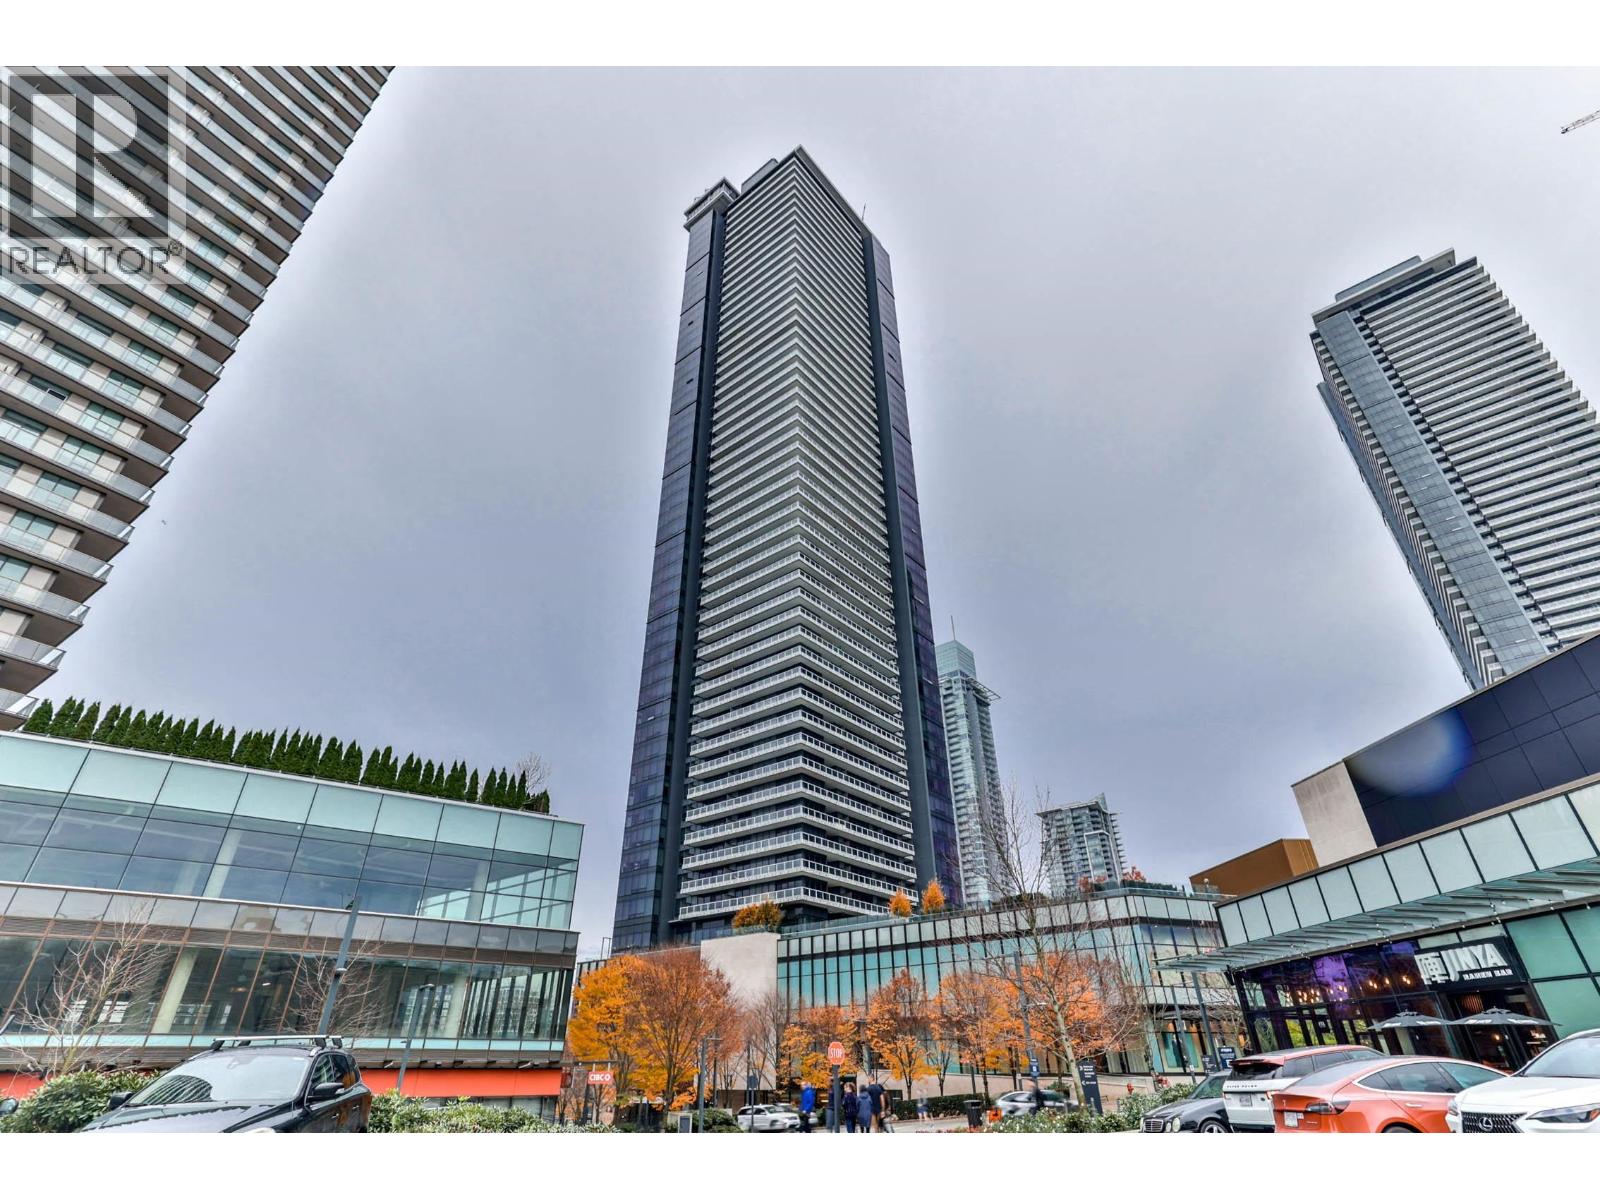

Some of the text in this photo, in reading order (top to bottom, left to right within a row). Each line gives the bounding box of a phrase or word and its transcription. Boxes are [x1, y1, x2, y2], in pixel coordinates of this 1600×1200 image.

[1440, 943, 1508, 983] JINYA
[1462, 968, 1514, 981] RAMEN BAR
[830, 1047, 843, 1058] STOP
